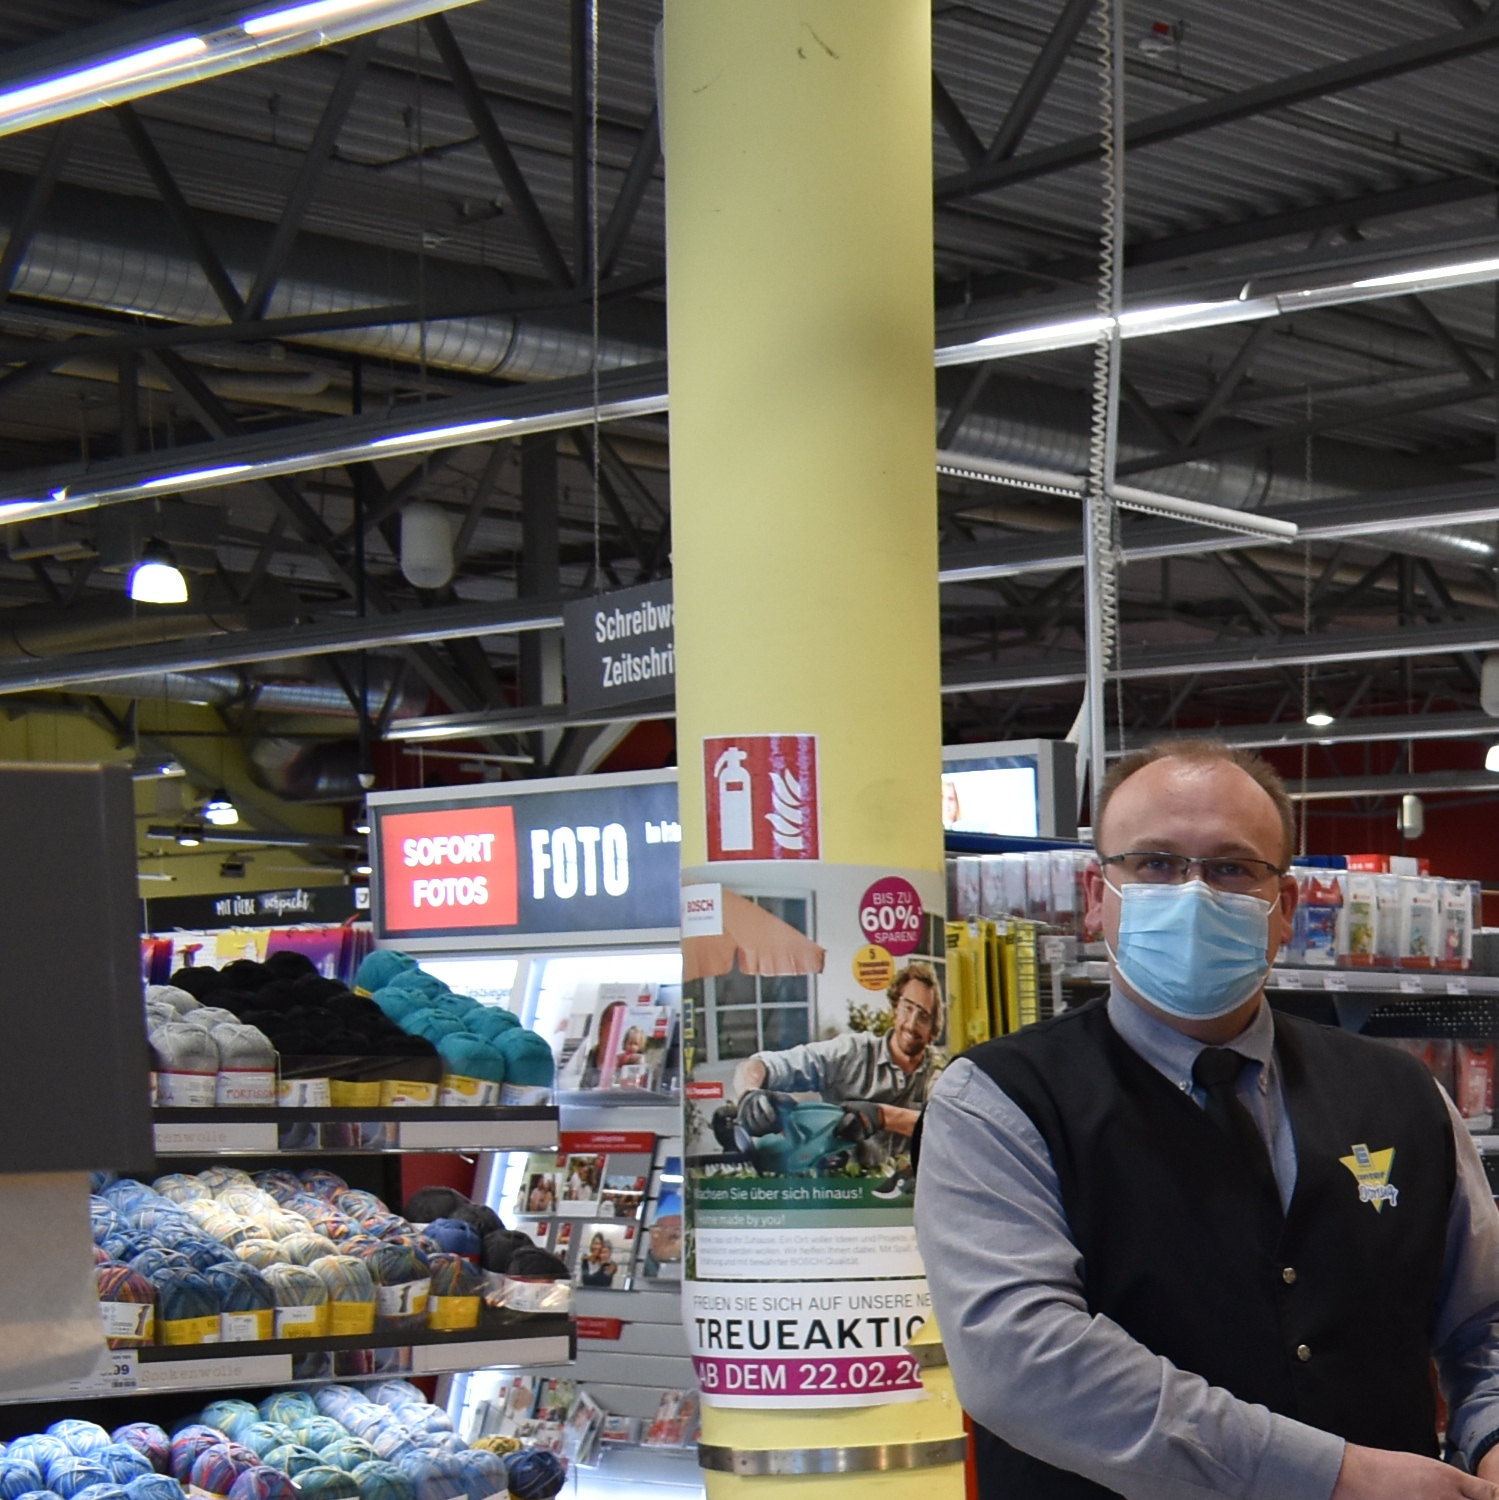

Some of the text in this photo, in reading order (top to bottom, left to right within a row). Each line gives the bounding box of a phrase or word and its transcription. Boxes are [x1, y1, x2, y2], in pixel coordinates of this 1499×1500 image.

[602, 643, 675, 688] Zeitschri
[403, 833, 495, 867] SOFORT
[530, 822, 629, 899] FOTO
[412, 876, 489, 908] FOTOS
[873, 892, 911, 904] BIS ZU
[687, 899, 714, 912] BOSCH
[875, 932, 917, 943] SPAREN!
[869, 948, 876, 959] 5
[729, 1187, 748, 1200] Sie
[750, 1188, 776, 1200] über
[781, 1187, 808, 1200] sich
[812, 1186, 863, 1200] hinaus!
[694, 1293, 931, 1311] FREUEN SIE SICH AUF UNSERE NE
[725, 1363, 787, 1389] DEM
